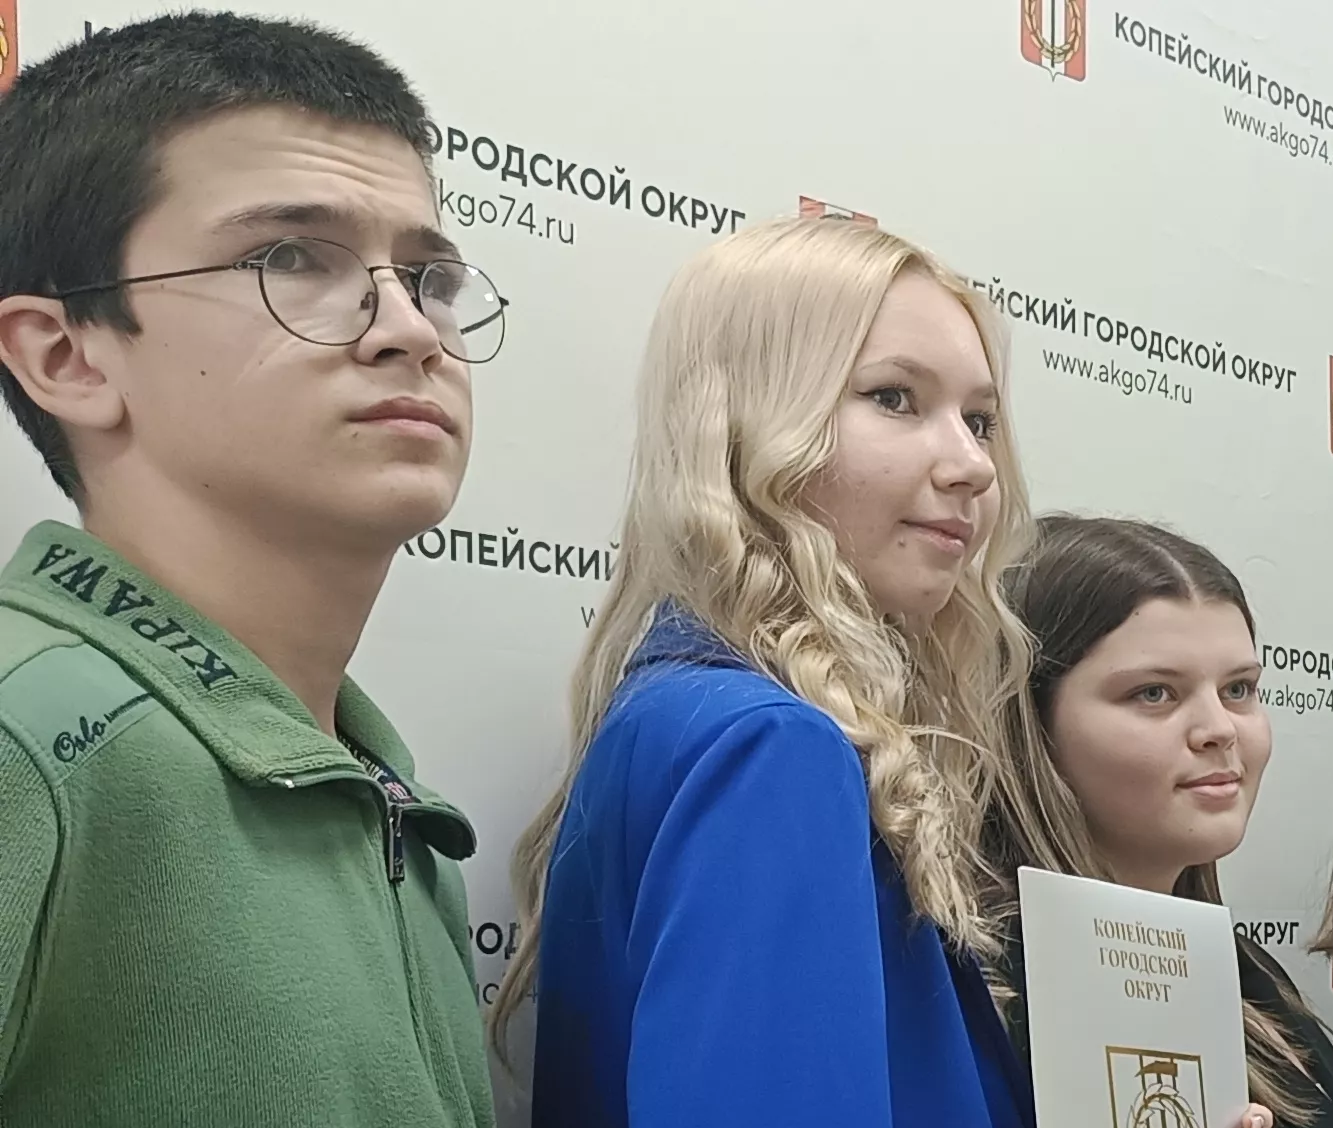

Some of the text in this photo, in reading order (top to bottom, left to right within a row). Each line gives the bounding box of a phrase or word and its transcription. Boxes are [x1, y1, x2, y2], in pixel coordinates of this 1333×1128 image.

[1115, 12, 1251, 94] КОПЕЙСКИЙ
[641, 185, 746, 234] ОКРУГ
[972, 276, 1297, 393] ЙСКИЙ ГОРОДСКОЙ ОКРУГ
[1043, 348, 1193, 404] www.akgo74.ru
[1094, 917, 1187, 952] КОПЕЙСКИЙ
[1233, 921, 1300, 945] ОКРУГ
[1099, 945, 1189, 979] ГОРОДСКОЙ
[1124, 978, 1172, 1004] ОКРУГ
